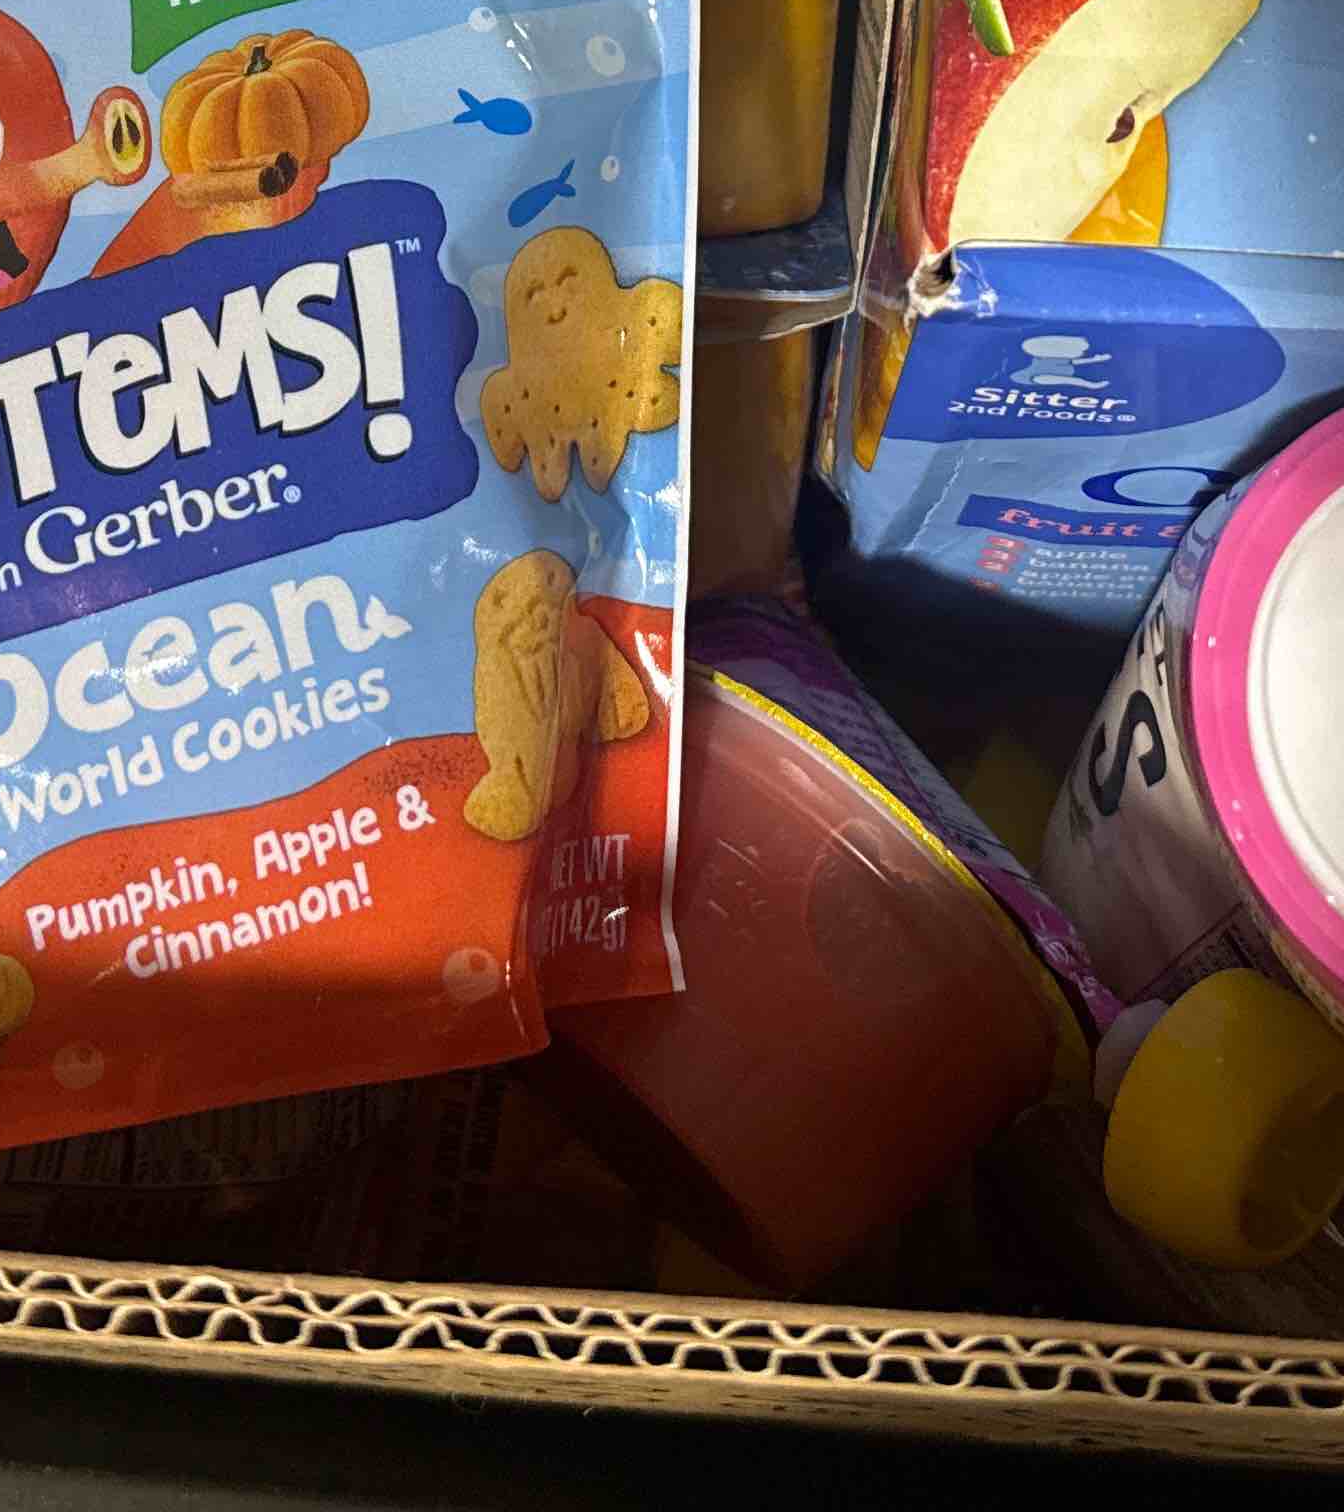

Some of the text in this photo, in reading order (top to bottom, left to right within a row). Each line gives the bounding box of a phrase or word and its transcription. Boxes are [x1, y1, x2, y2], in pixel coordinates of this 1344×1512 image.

[947, 399, 1007, 417] 2nd
[971, 387, 1129, 411] Sitter
[996, 506, 1140, 539] fruit
[173, 665, 392, 768] Cookies
[27, 784, 436, 952] Pumpkin, Apple &
